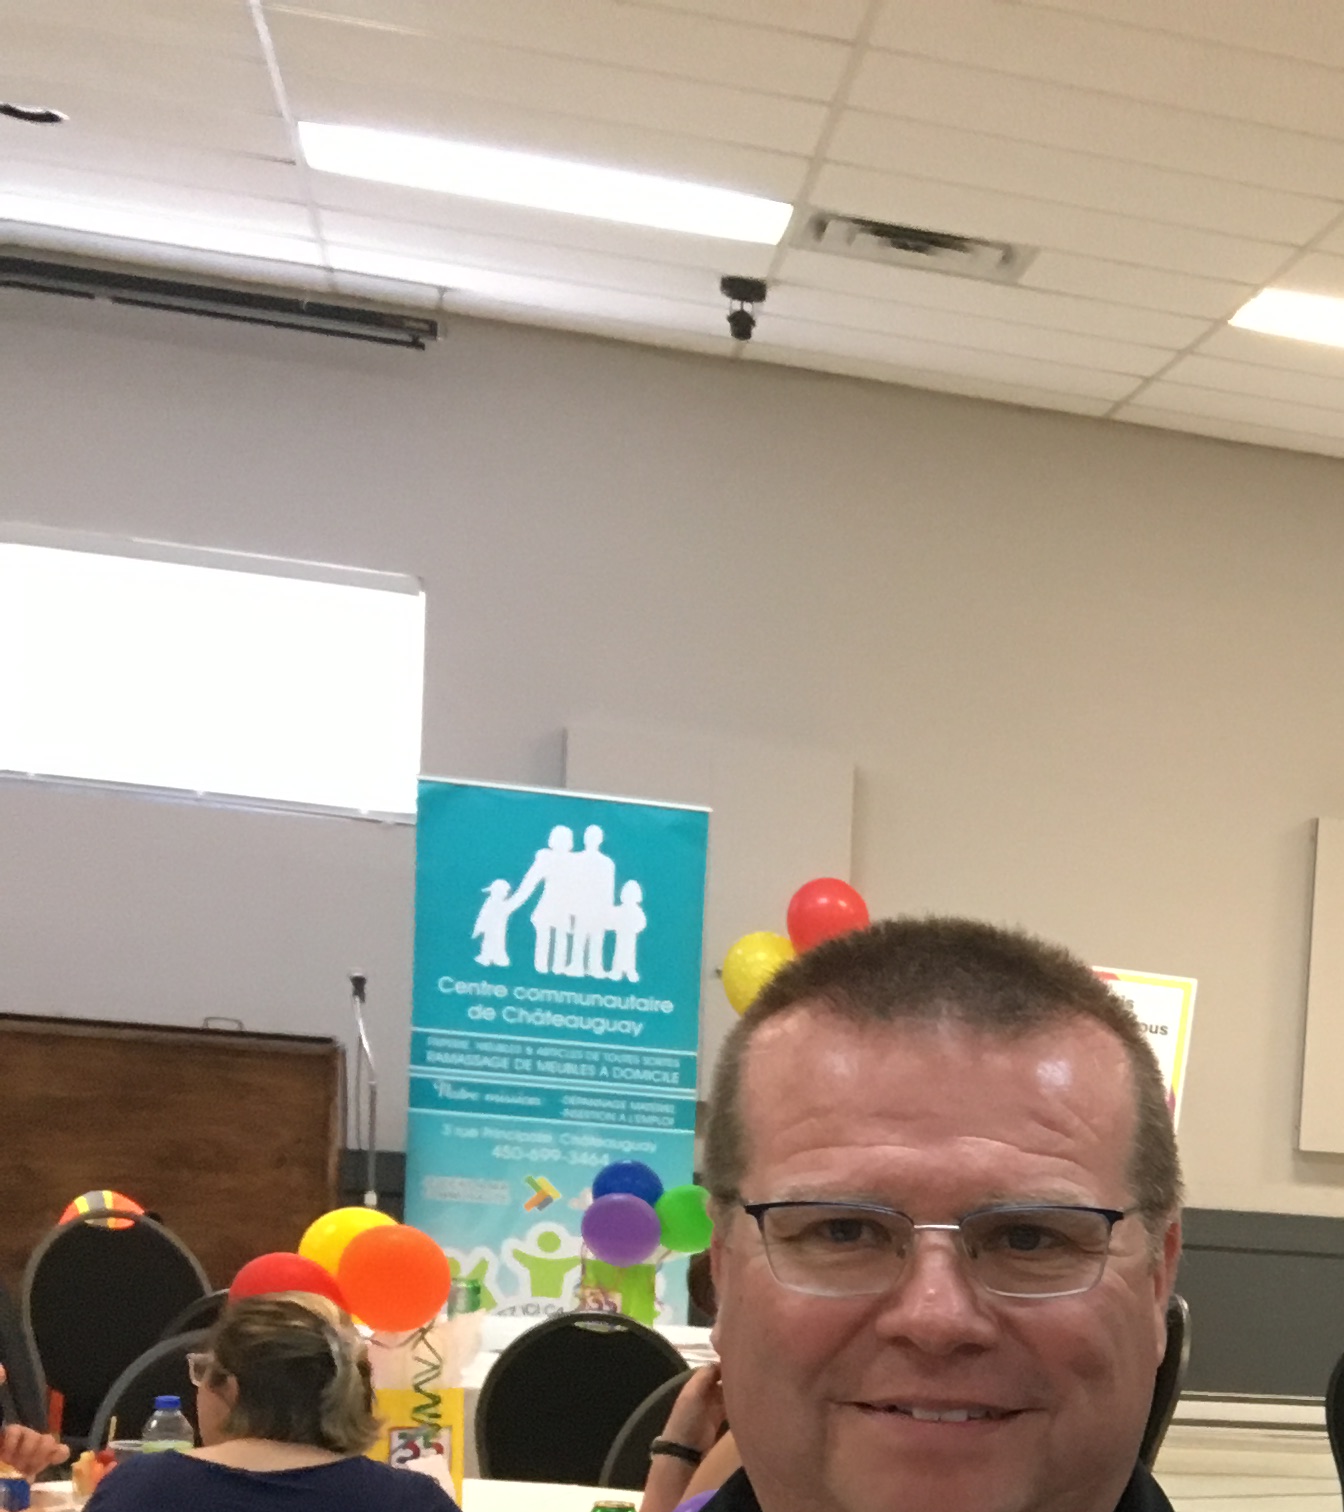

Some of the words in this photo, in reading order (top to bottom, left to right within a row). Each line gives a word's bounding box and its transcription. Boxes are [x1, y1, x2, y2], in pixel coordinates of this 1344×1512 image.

[437, 975, 509, 999] Centre
[512, 985, 674, 1014] communautaire
[467, 1003, 497, 1021] de
[501, 1005, 644, 1037] Châteauguay
[425, 1050, 510, 1070] RAMASSAGE
[513, 1057, 532, 1071] DE
[536, 1059, 597, 1077] MEUBLES
[611, 1066, 680, 1085] DOMICILE
